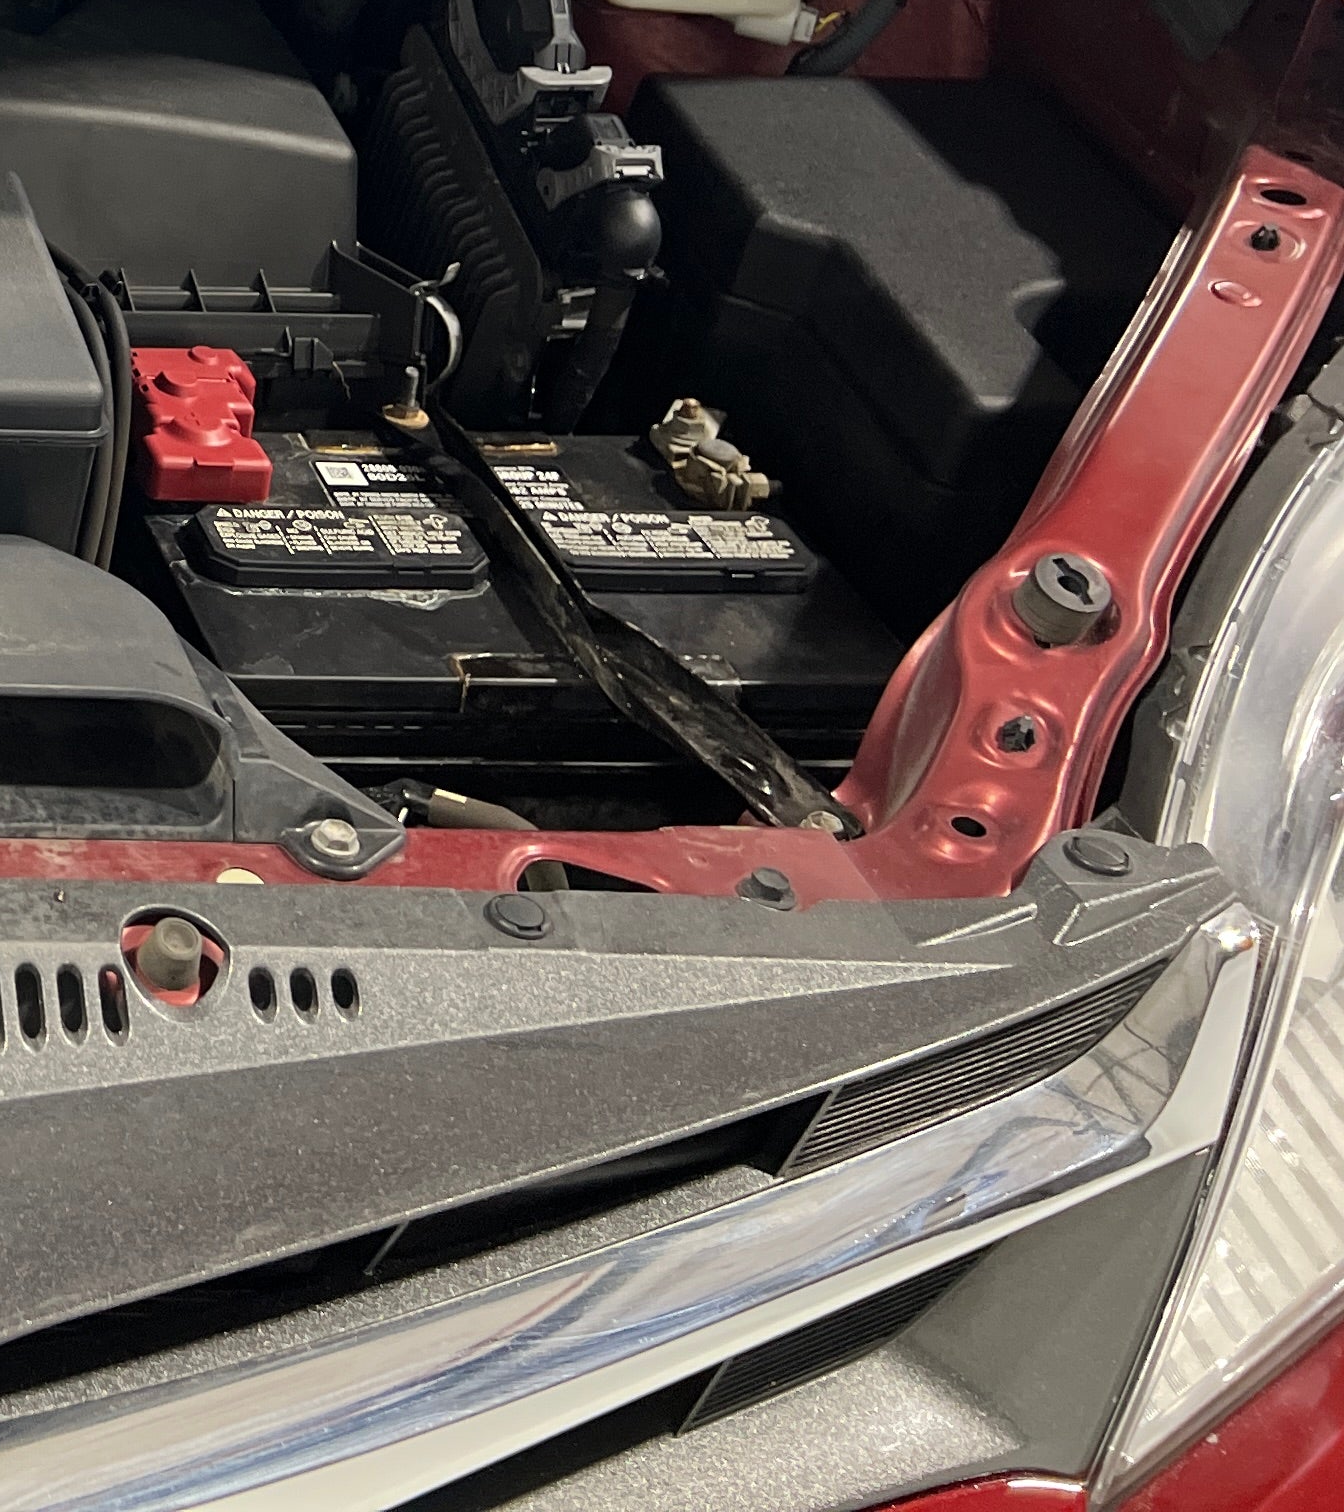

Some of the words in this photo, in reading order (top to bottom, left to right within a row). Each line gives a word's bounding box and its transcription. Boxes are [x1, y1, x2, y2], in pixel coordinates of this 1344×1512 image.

[232, 508, 285, 519] DANGER
[296, 509, 345, 520] POISON
[557, 512, 610, 522] DANGER
[620, 513, 670, 524] POISON
